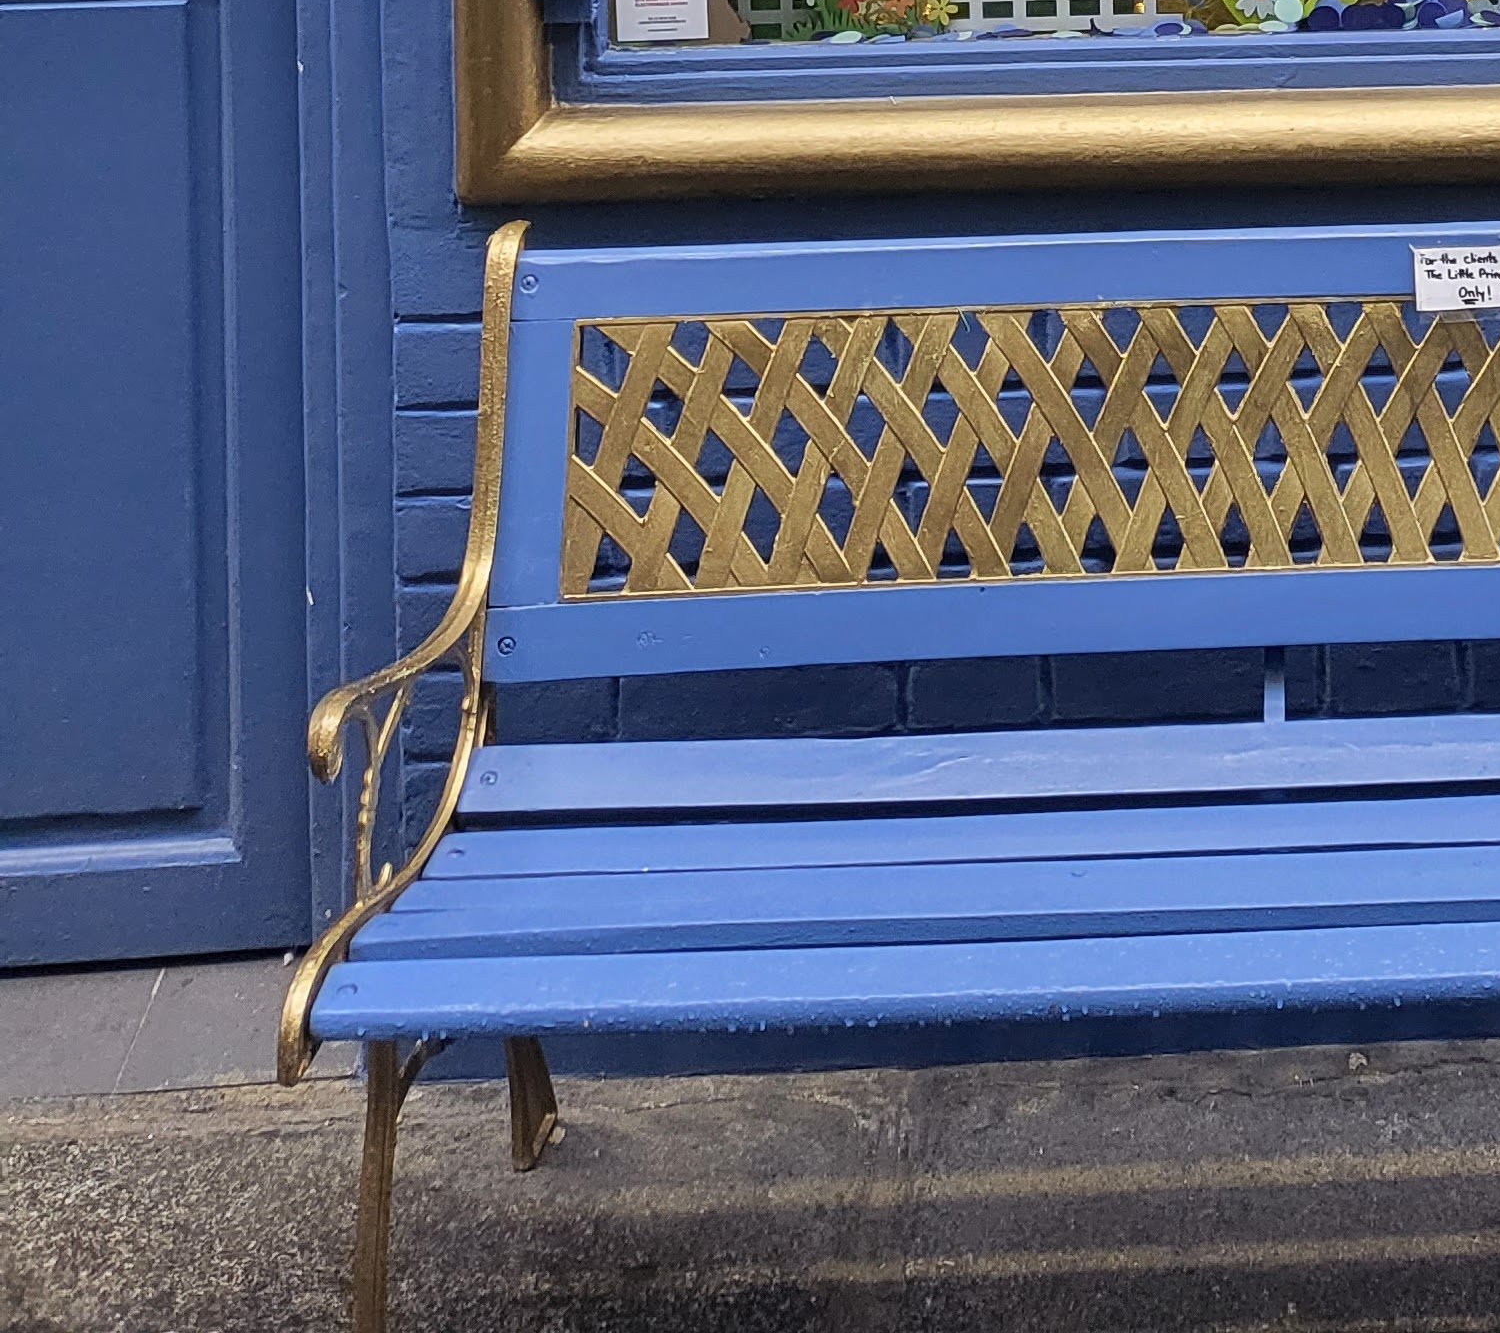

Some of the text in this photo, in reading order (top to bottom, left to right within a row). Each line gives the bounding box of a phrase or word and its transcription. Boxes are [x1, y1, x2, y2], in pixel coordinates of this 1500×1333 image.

[1440, 253, 1457, 264] the
[1424, 269, 1443, 279] The
[1458, 285, 1492, 302] Only!
